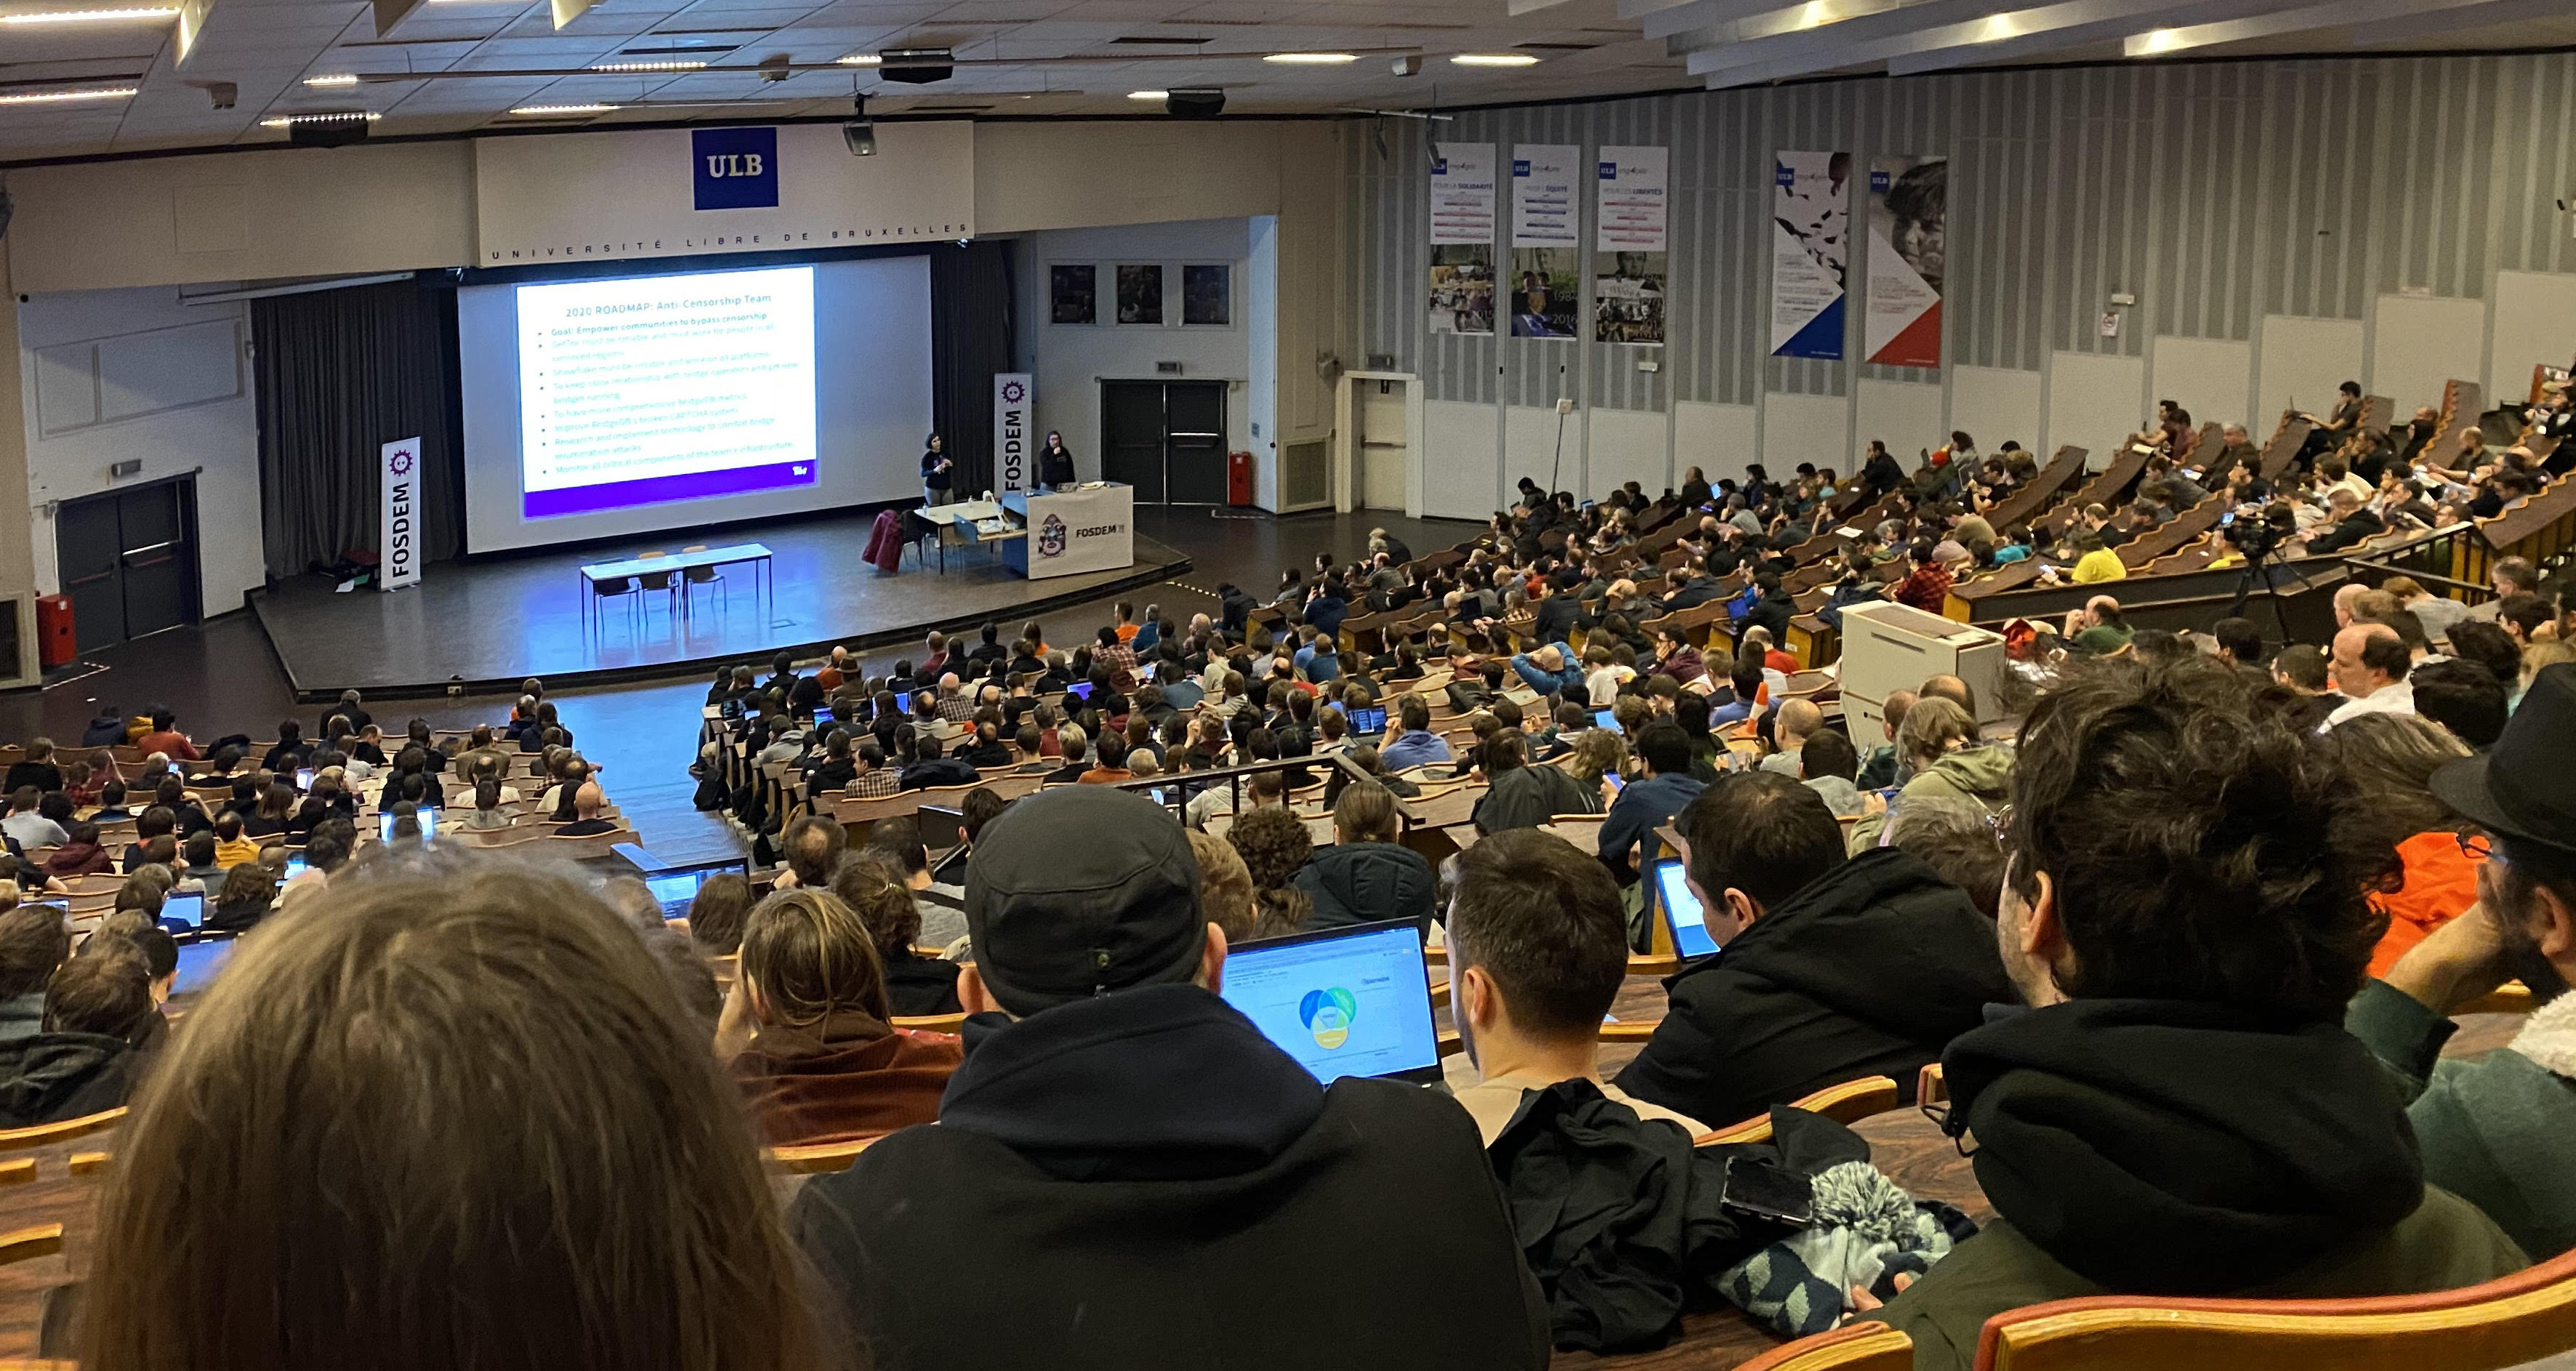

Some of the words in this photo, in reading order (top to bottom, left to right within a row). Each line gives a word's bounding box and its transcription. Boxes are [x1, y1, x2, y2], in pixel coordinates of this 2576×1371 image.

[706, 153, 764, 178] ULB
[491, 240, 661, 260] UNIVERSITÉ
[686, 235, 760, 248] LIBRE
[784, 233, 808, 242] DE
[832, 224, 965, 239] BRUXELLES
[565, 306, 591, 317] 2020
[595, 302, 653, 315] ROADMAP:
[744, 293, 771, 304] Team
[551, 327, 572, 336] Goal:
[576, 323, 617, 335] Empower
[621, 319, 677, 330] communities
[691, 315, 720, 326] bypass
[722, 312, 767, 323] censorship
[1005, 410, 1021, 491] FOSDEM
[393, 482, 409, 577] FOSDEM
[1076, 524, 1116, 538] FOSDEM
